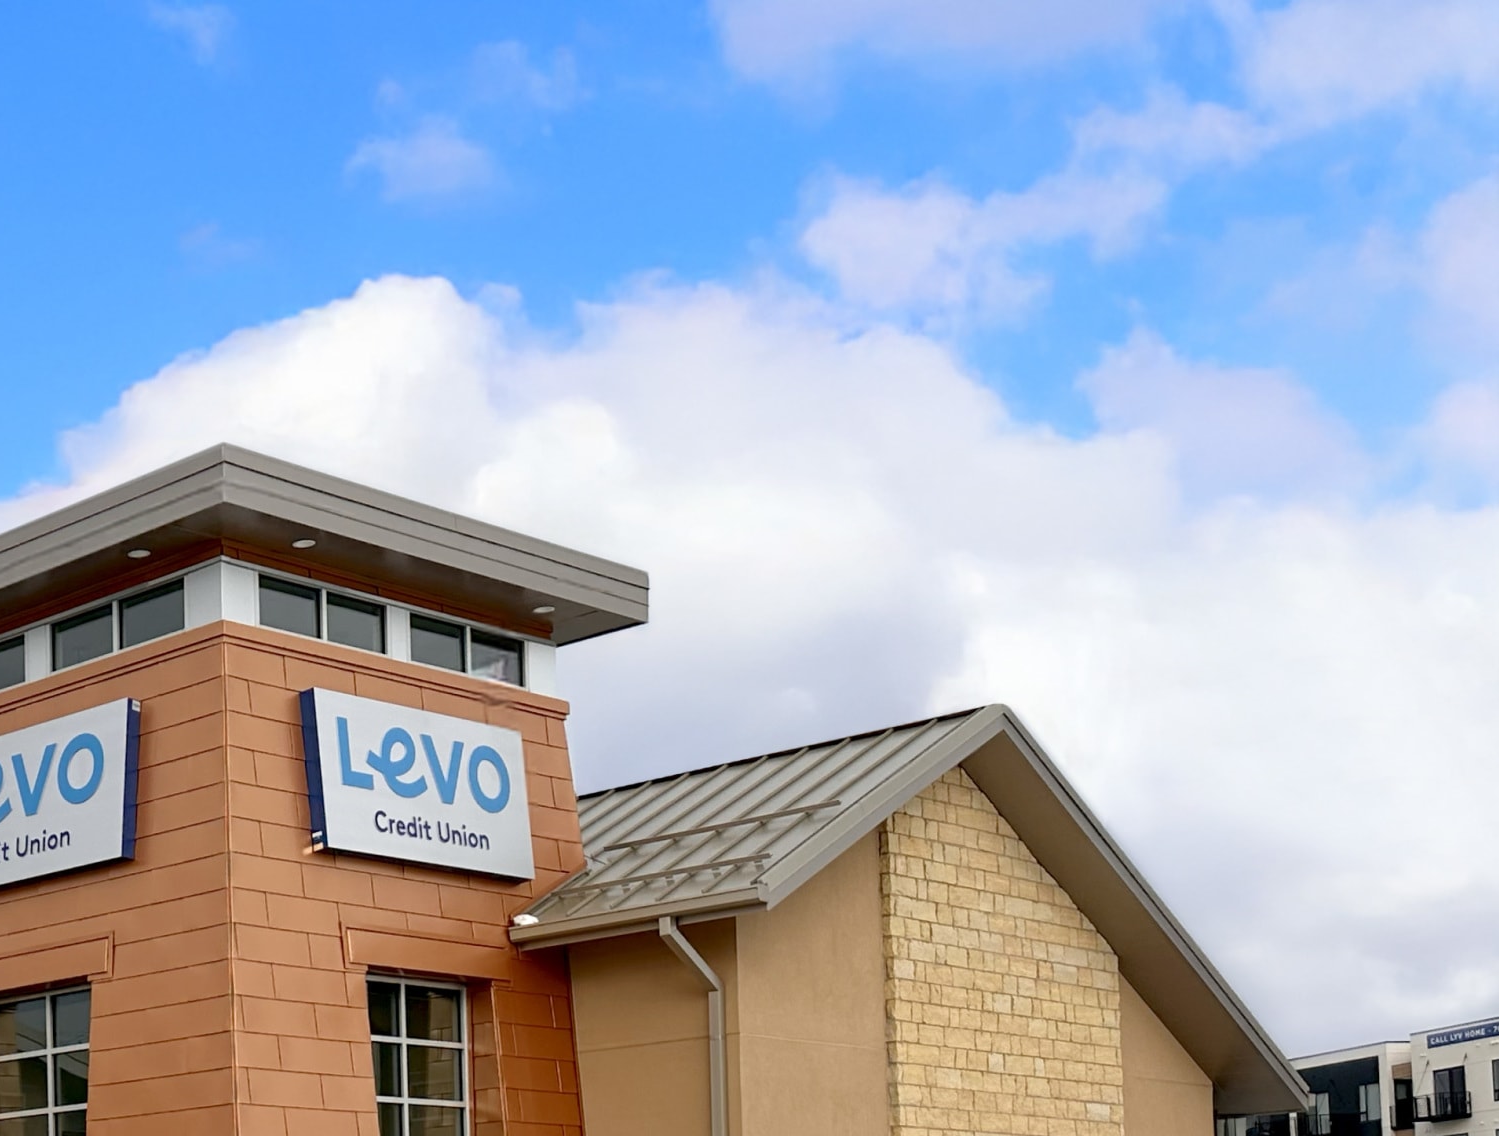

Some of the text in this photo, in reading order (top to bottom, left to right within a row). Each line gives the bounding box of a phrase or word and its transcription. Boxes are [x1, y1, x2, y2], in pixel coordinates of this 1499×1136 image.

[15, 830, 70, 857] Union
[374, 810, 490, 850] Credit Union
[1430, 1035, 1448, 1045] CALL
[1465, 1027, 1486, 1039] HOME
